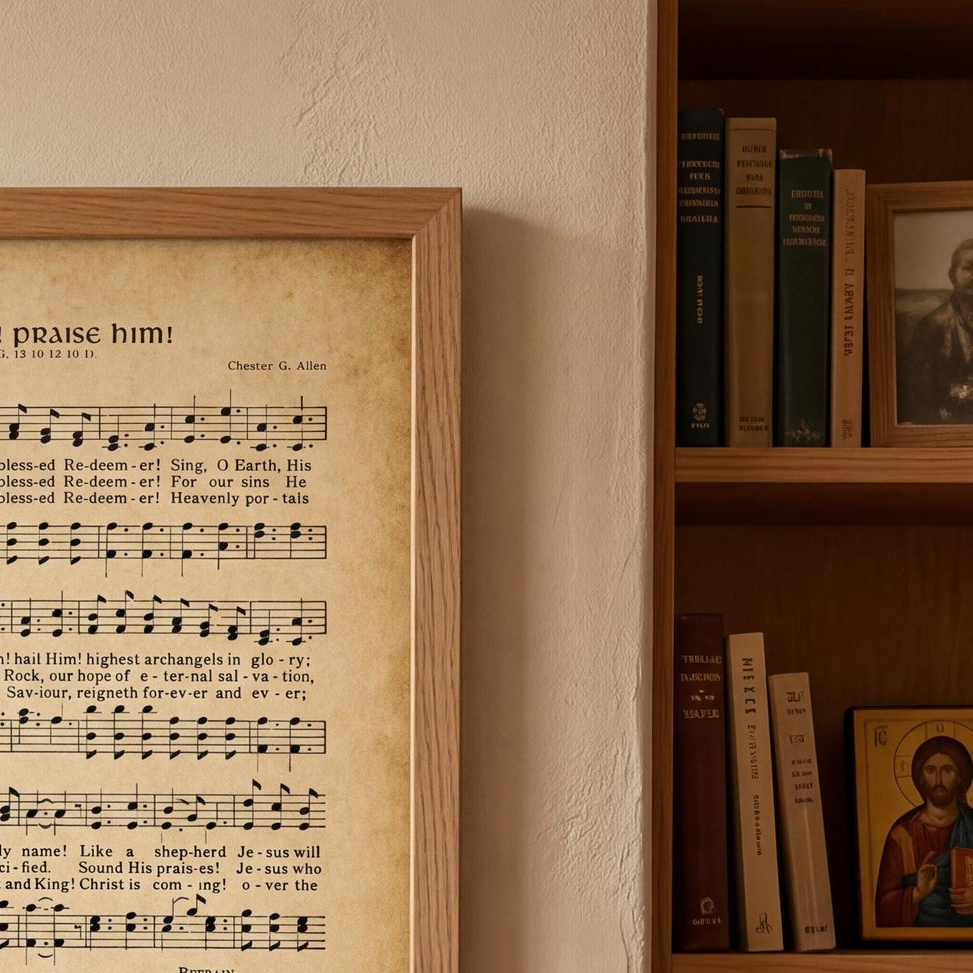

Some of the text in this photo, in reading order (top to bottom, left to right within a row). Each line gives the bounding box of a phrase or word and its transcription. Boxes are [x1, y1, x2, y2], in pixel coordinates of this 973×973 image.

[15, 348, 27, 359] 13
[31, 348, 45, 359] 10
[48, 348, 62, 359] 12
[66, 348, 80, 359] 10
[227, 360, 327, 371] Chester G. Allen
[170, 458, 208, 475] Sing,
[234, 458, 282, 474] Earth,
[286, 458, 312, 472] His
[170, 474, 198, 489] For
[208, 478, 235, 488] our
[240, 474, 270, 489] sins
[285, 474, 307, 489] He
[170, 491, 240, 508] Heavenly
[13, 651, 42, 666] hail
[45, 651, 82, 666] Him!
[86, 651, 141, 671] highest
[143, 651, 224, 671] archangels
[3, 668, 45, 685] Rock,
[48, 671, 74, 682] our
[76, 667, 112, 687] hope
[76, 685, 139, 703] reigneth
[215, 685, 242, 700] and
[21, 844, 67, 858] name!
[79, 843, 114, 858] Like
[293, 844, 321, 859] will
[77, 860, 124, 875] Sound
[127, 860, 153, 875] His
[291, 862, 323, 875] who
[2, 877, 32, 891] and
[33, 876, 75, 894] King!
[78, 877, 126, 891] Christ
[294, 878, 319, 892] the
